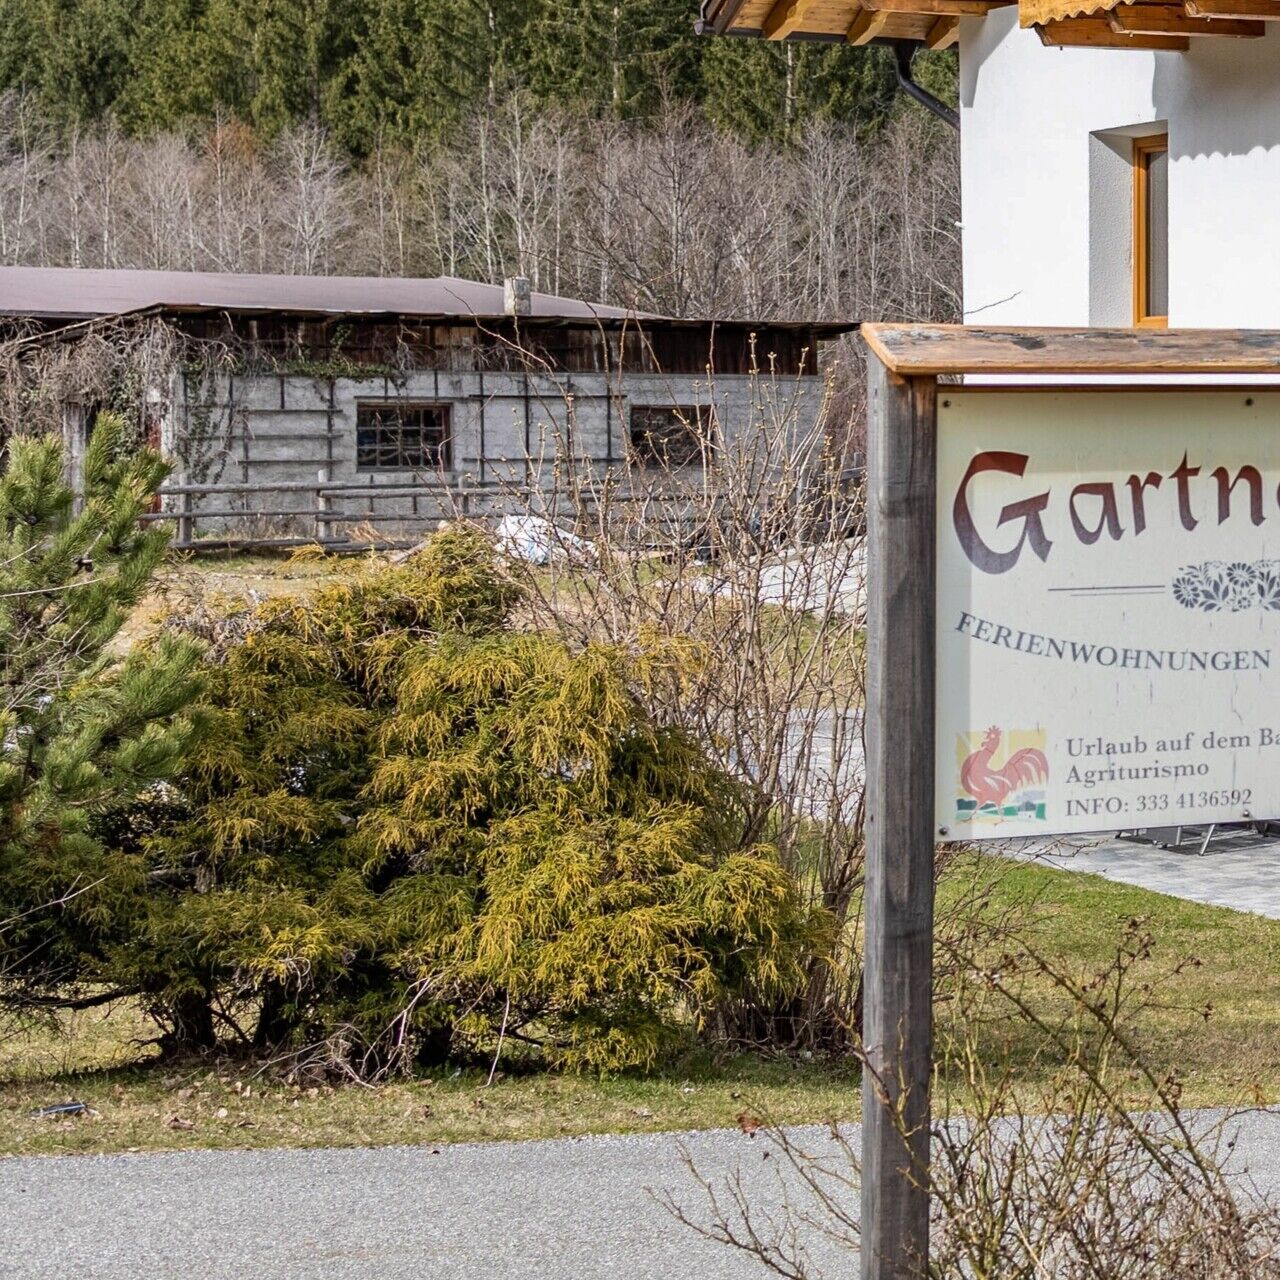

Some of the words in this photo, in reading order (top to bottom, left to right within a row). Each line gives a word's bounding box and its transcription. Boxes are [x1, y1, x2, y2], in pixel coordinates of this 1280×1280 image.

[954, 611, 1272, 671] FERIENWOHNUNGEN
[1066, 735, 1148, 757] Urlaub
[1155, 731, 1195, 753] auf
[1202, 731, 1252, 750] dem
[1065, 759, 1210, 789] Agriturismo
[1065, 796, 1129, 816] INFO:
[1136, 793, 1169, 812] 333
[1175, 788, 1253, 810] 4136592
